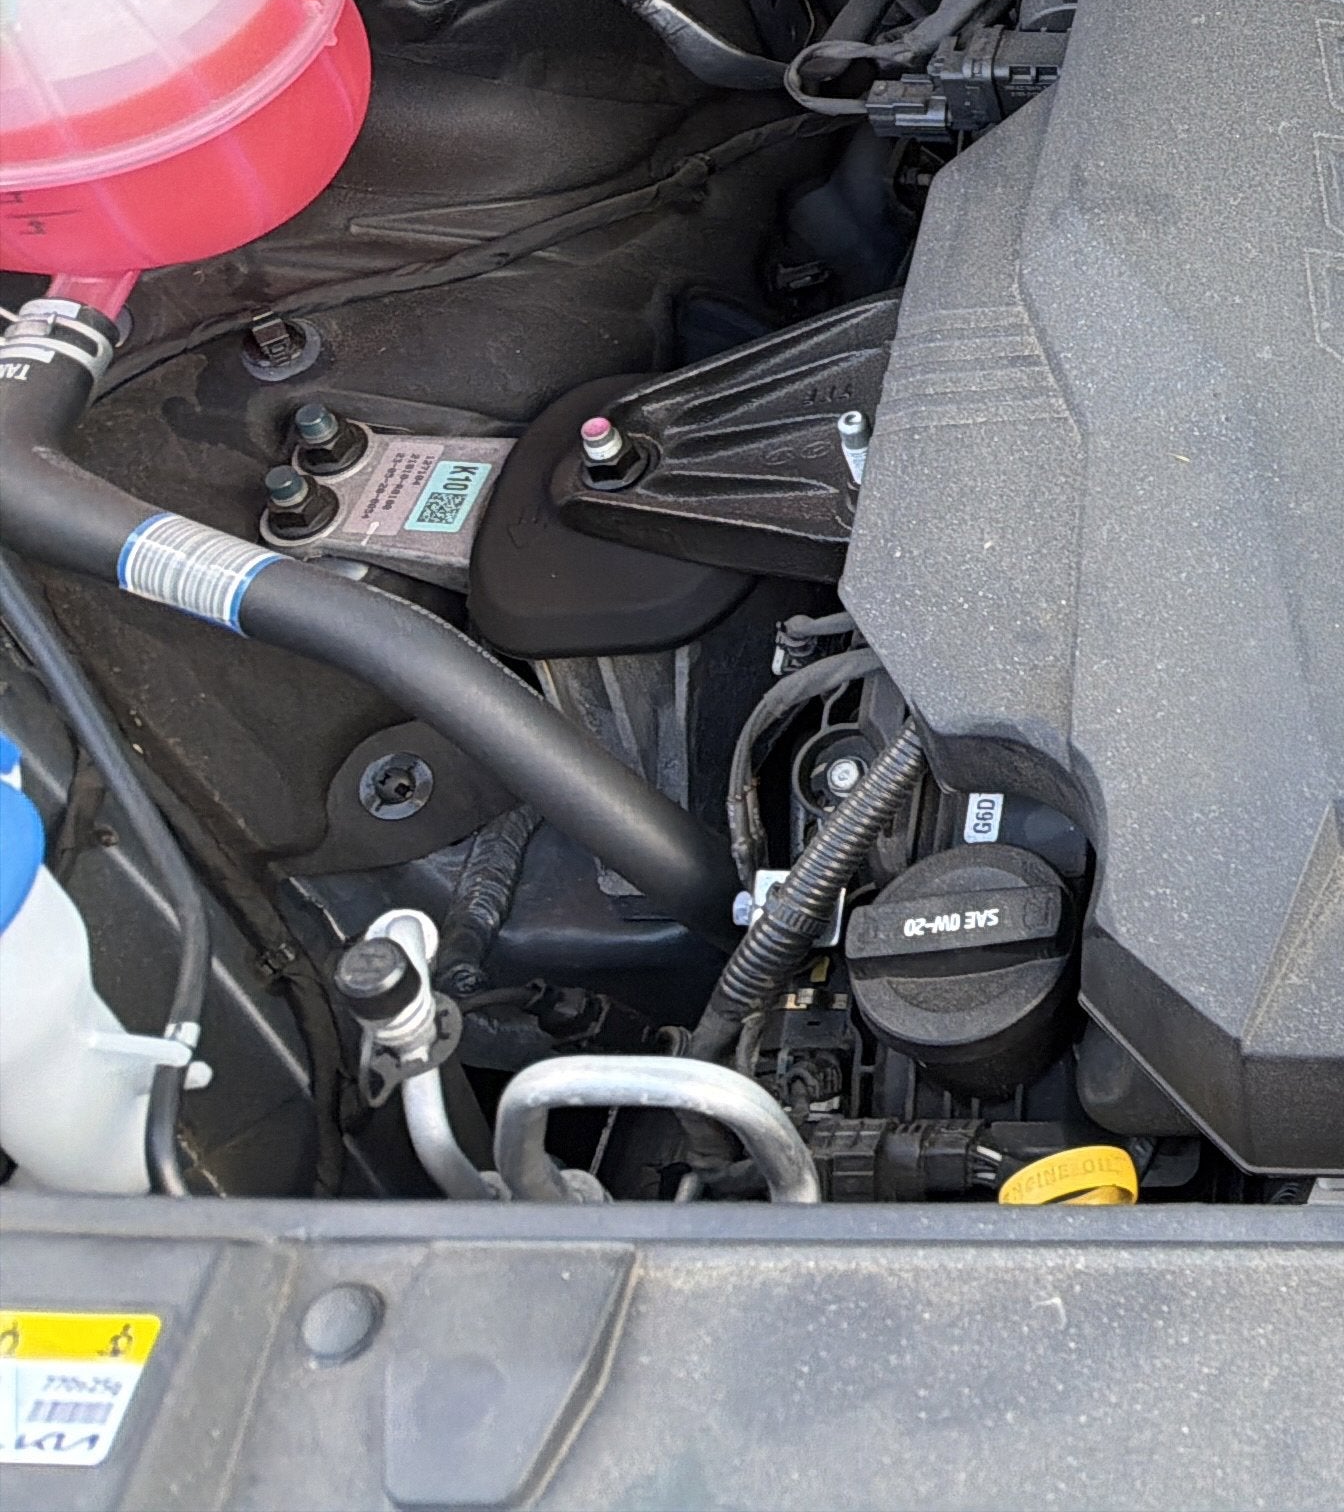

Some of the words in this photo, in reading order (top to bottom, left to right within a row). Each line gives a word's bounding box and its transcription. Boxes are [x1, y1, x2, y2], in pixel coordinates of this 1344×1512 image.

[442, 465, 480, 491] K10
[972, 798, 996, 836] G6D
[904, 912, 962, 937] 0W-20
[965, 908, 999, 930] SAE
